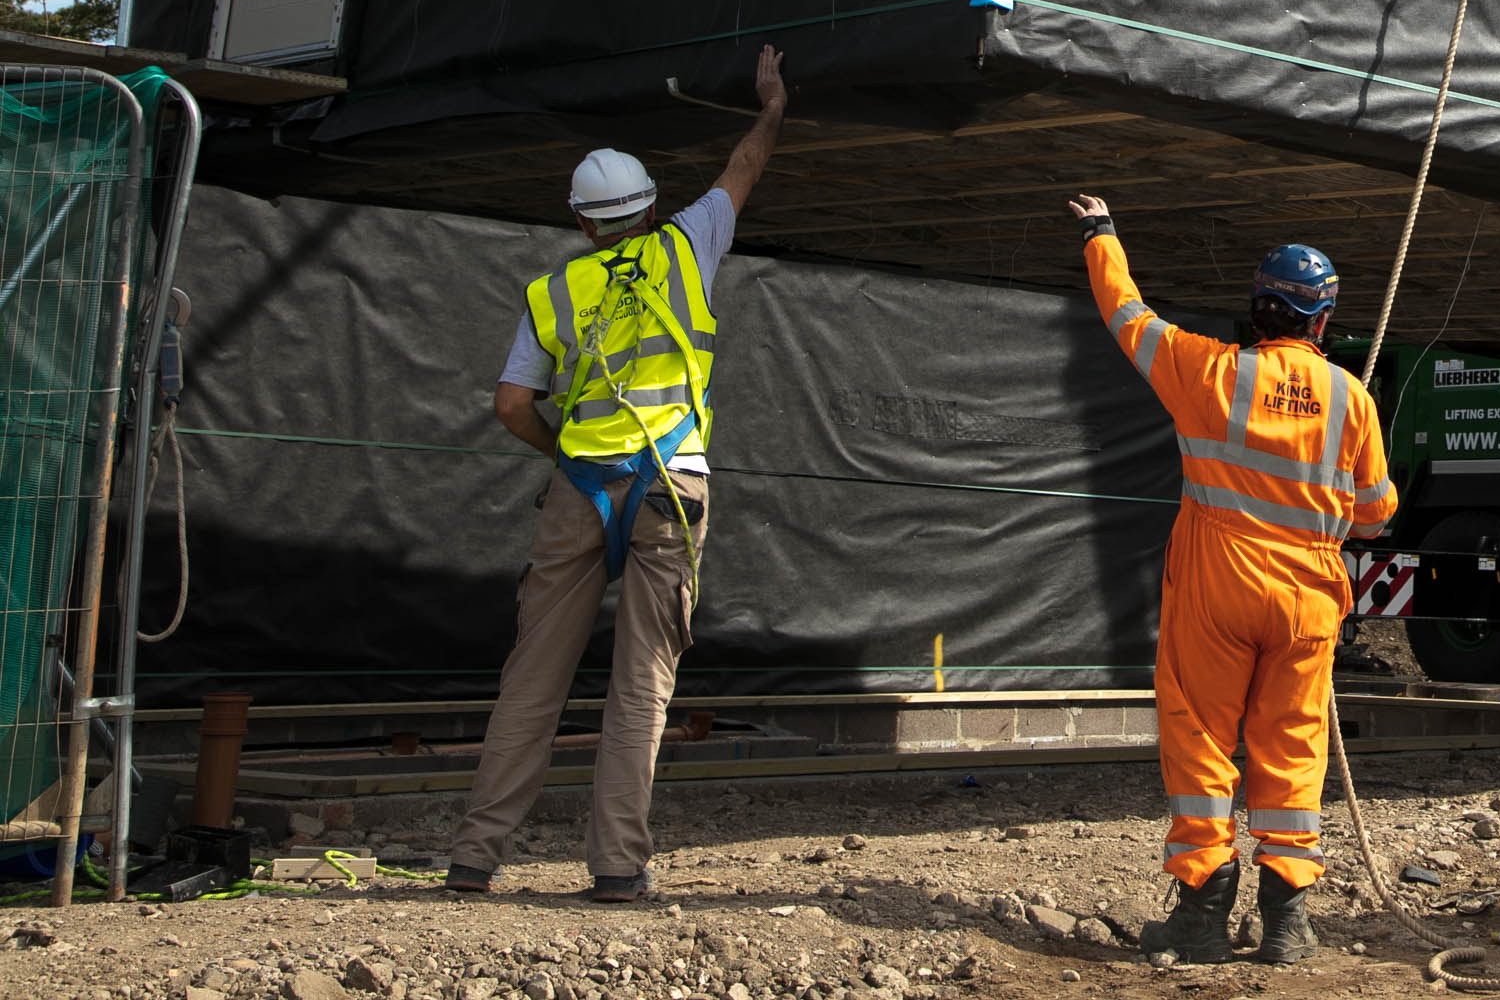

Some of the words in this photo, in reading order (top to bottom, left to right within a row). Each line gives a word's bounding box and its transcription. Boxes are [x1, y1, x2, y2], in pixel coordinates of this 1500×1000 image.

[1435, 370, 1500, 387] LIEBHERR
[1276, 381, 1312, 399] KING
[1263, 394, 1320, 414] LIFTING
[1445, 408, 1485, 420] LIFTING
